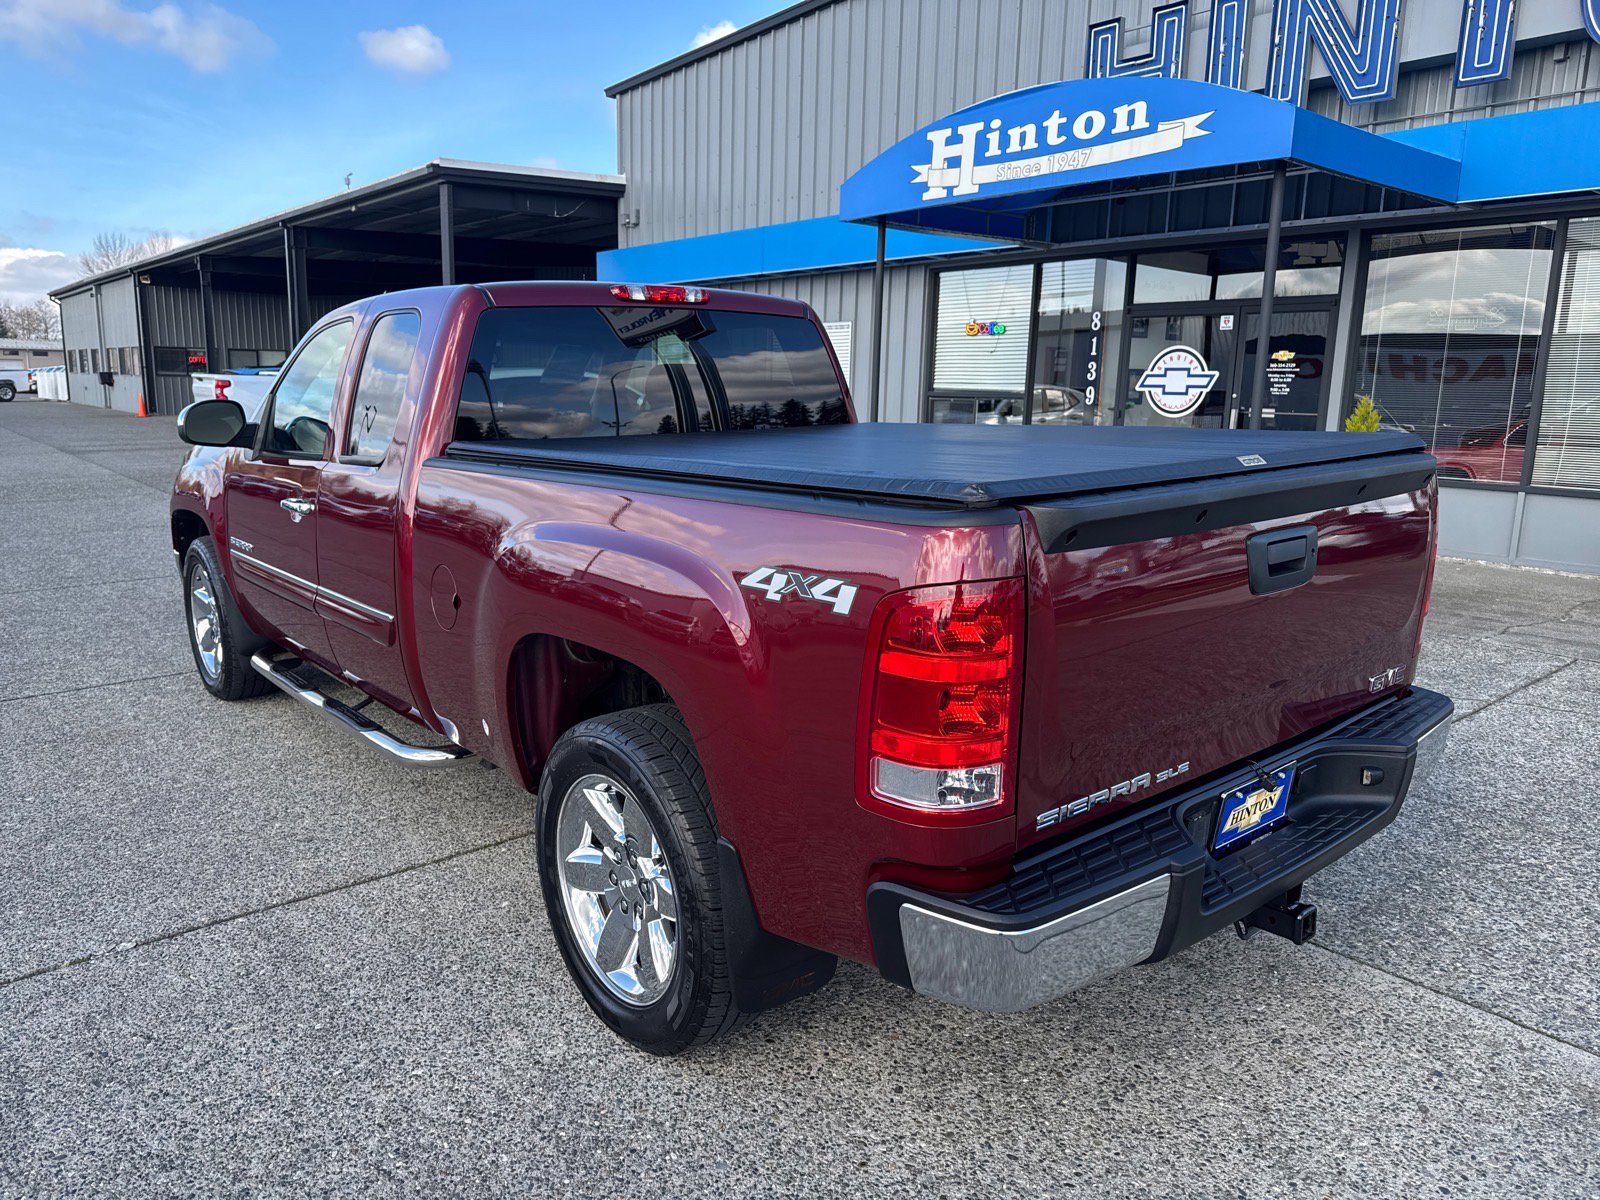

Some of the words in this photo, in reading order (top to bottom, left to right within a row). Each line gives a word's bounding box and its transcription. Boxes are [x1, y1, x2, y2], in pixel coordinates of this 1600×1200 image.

[922, 101, 1150, 201] Hinton
[996, 162, 1041, 181] Since
[1047, 148, 1093, 173] 1947
[1369, 664, 1407, 694] GMC
[1036, 772, 1151, 832] SIERRA
[1156, 761, 1190, 783] SLE
[1230, 793, 1277, 827] HINTON
